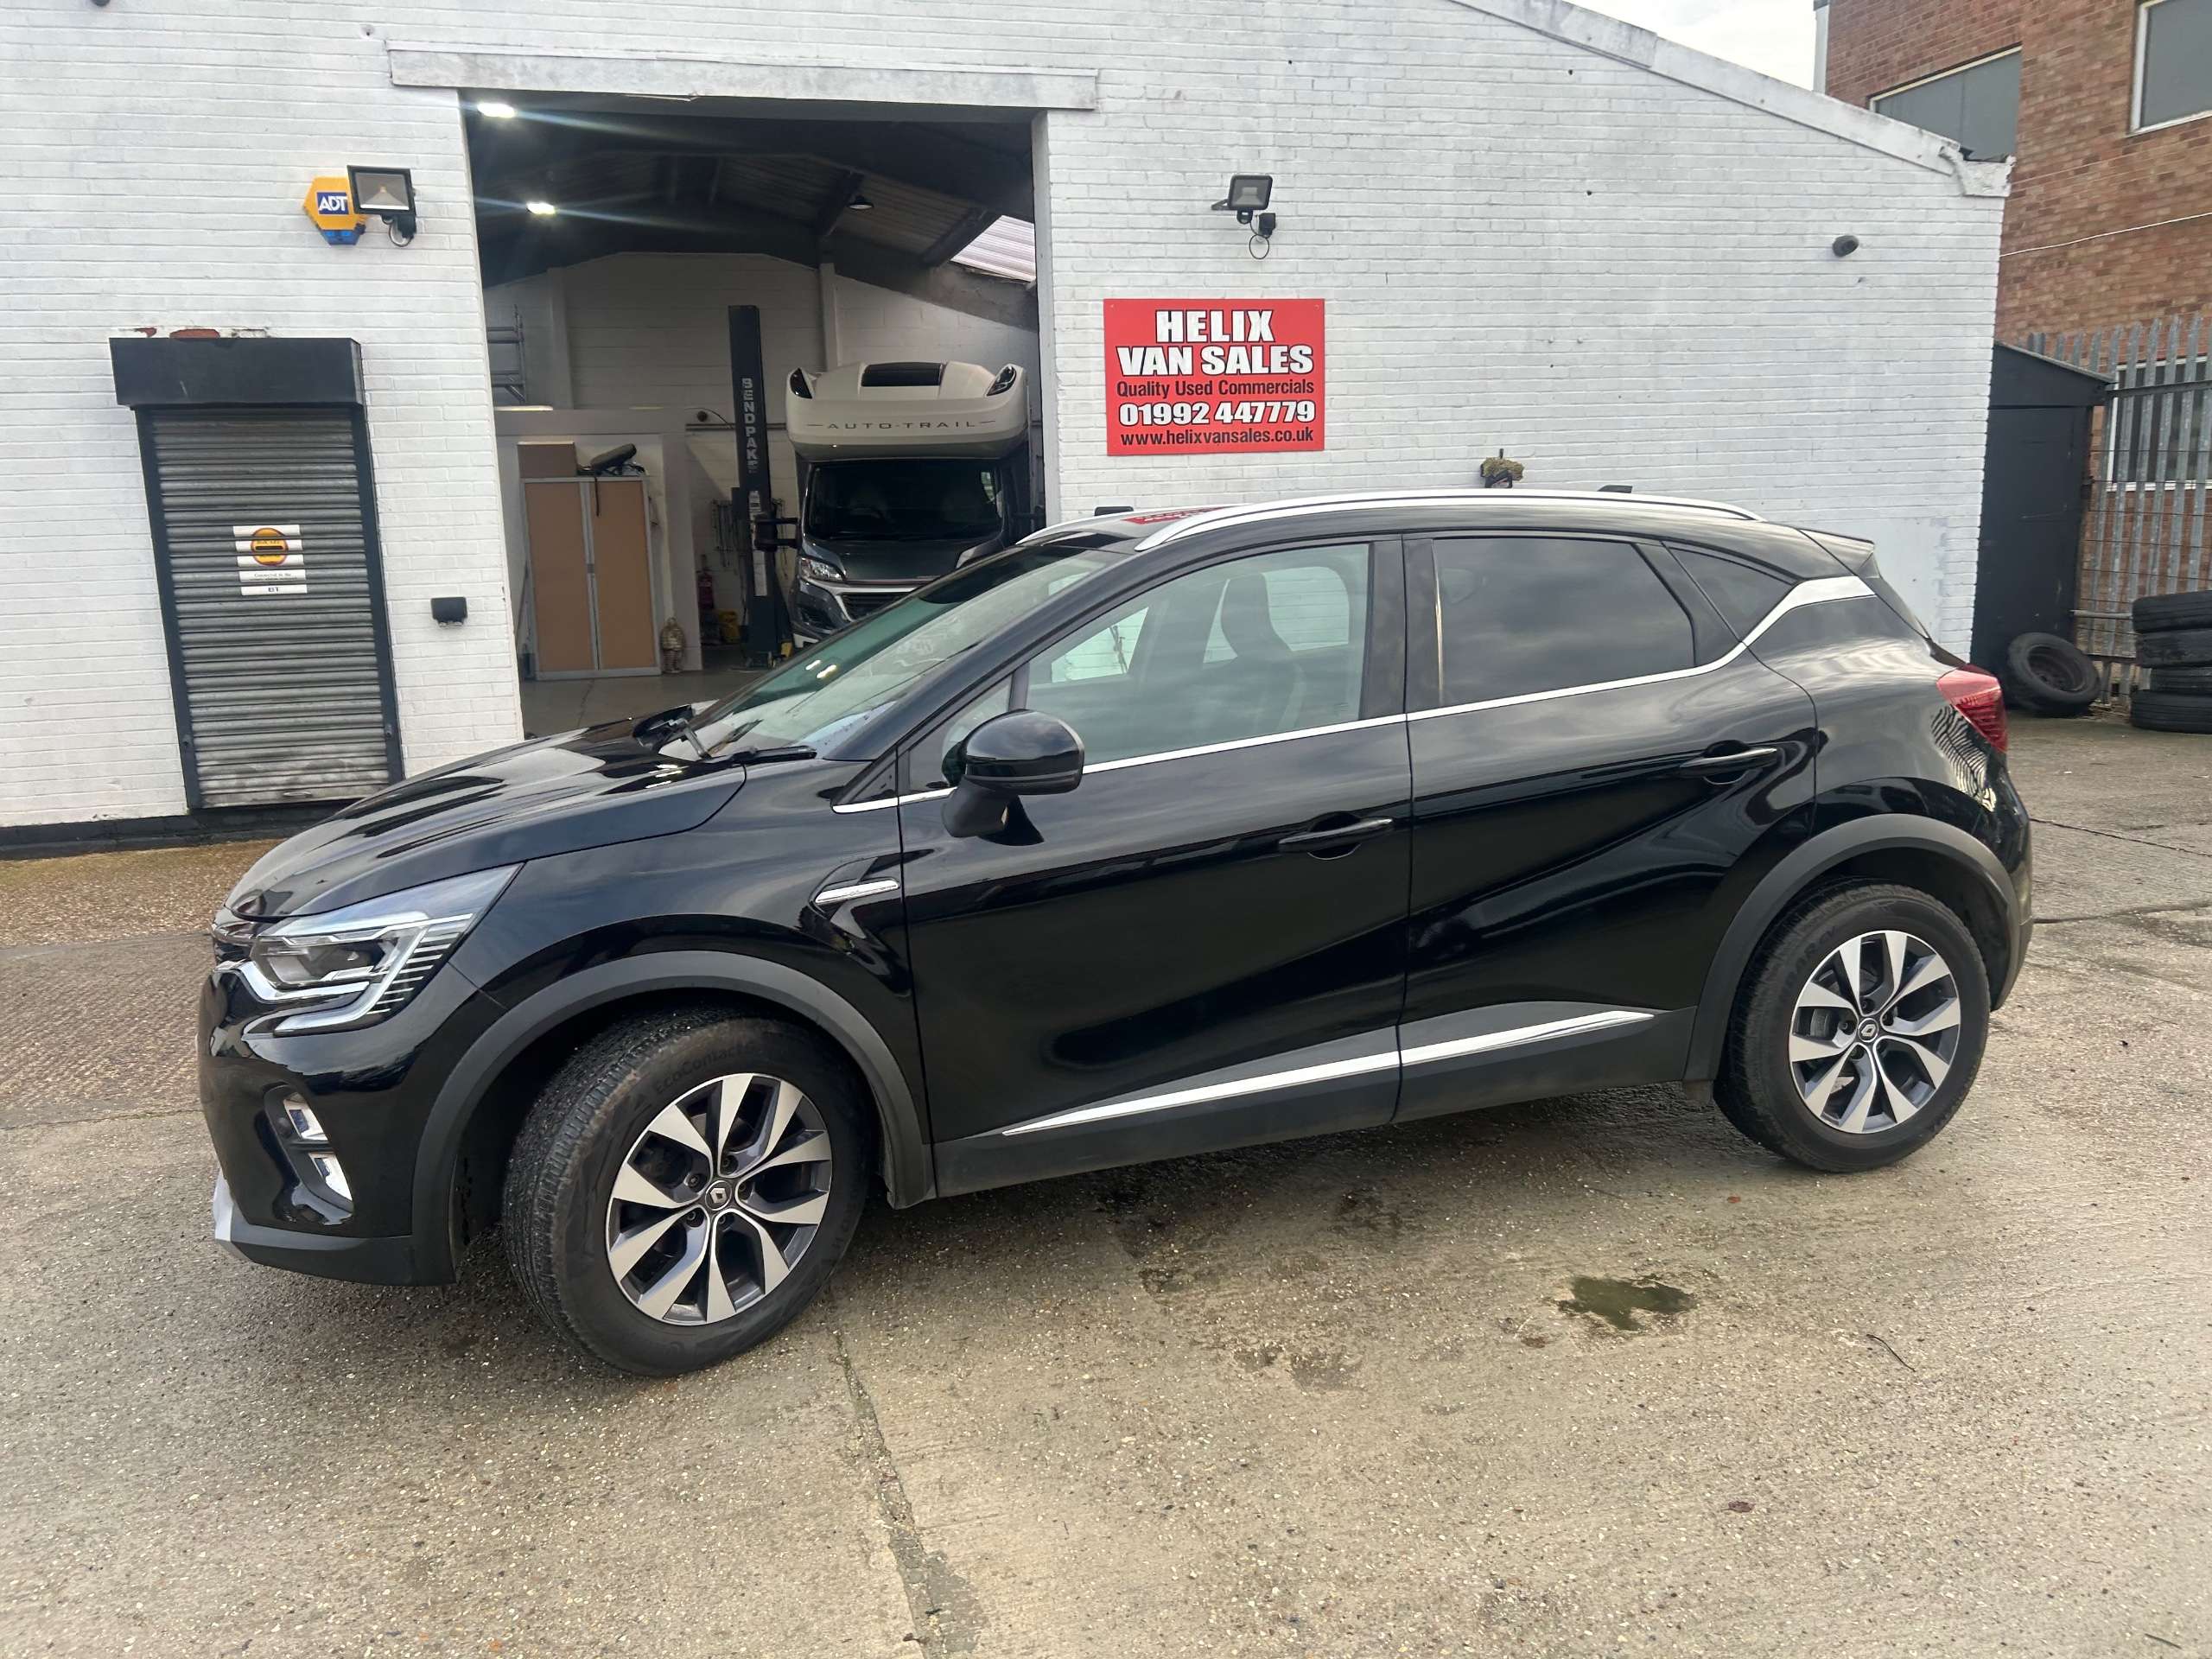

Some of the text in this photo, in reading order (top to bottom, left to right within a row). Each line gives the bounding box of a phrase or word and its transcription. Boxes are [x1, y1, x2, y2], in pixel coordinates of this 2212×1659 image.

[318, 195, 347, 211] ADT
[1155, 309, 1274, 343] HELIX
[1116, 344, 1314, 376] VAN SALES
[1116, 378, 1314, 398] Quality Used Commercials
[1119, 400, 1315, 426] 01992 447779
[1121, 427, 1313, 445] www.helixvansales.co.uk
